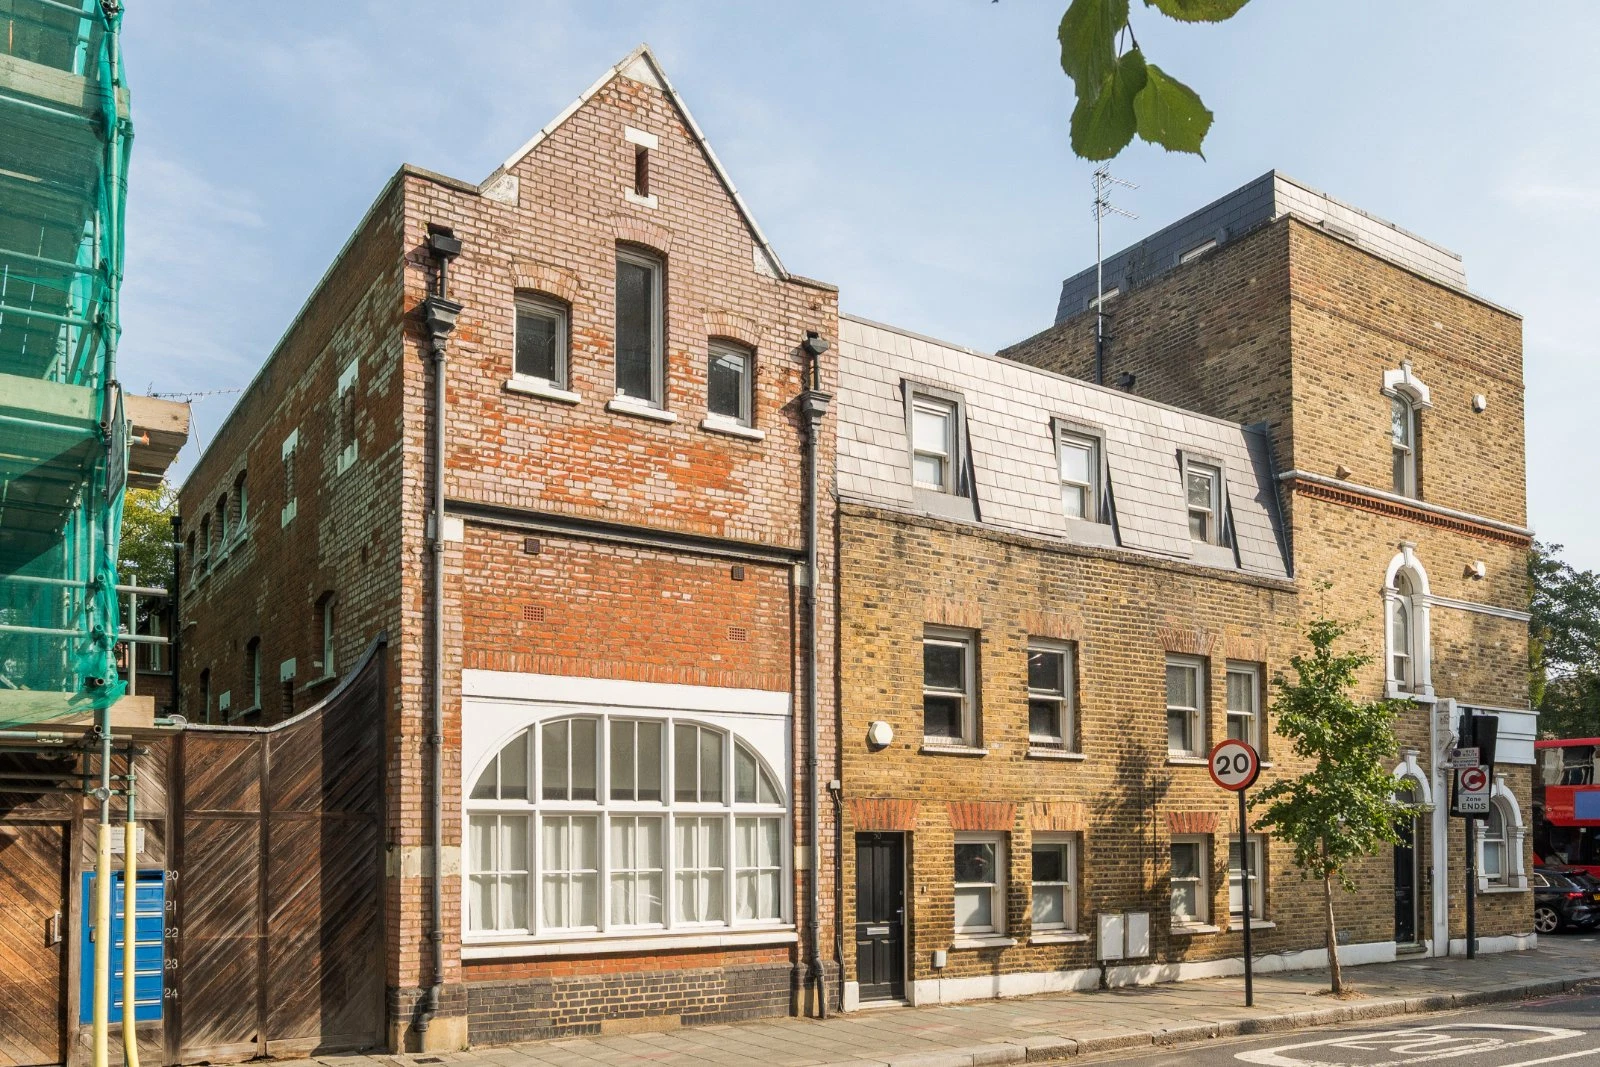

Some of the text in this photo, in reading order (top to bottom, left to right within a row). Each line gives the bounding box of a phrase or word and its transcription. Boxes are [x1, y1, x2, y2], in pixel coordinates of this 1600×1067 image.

[1216, 753, 1249, 775] 20
[165, 870, 178, 880] 20
[165, 900, 177, 911] 21
[165, 928, 178, 938] 22
[164, 959, 178, 969] 23
[164, 988, 178, 998] 24
[1328, 1033, 1503, 1054] 20
